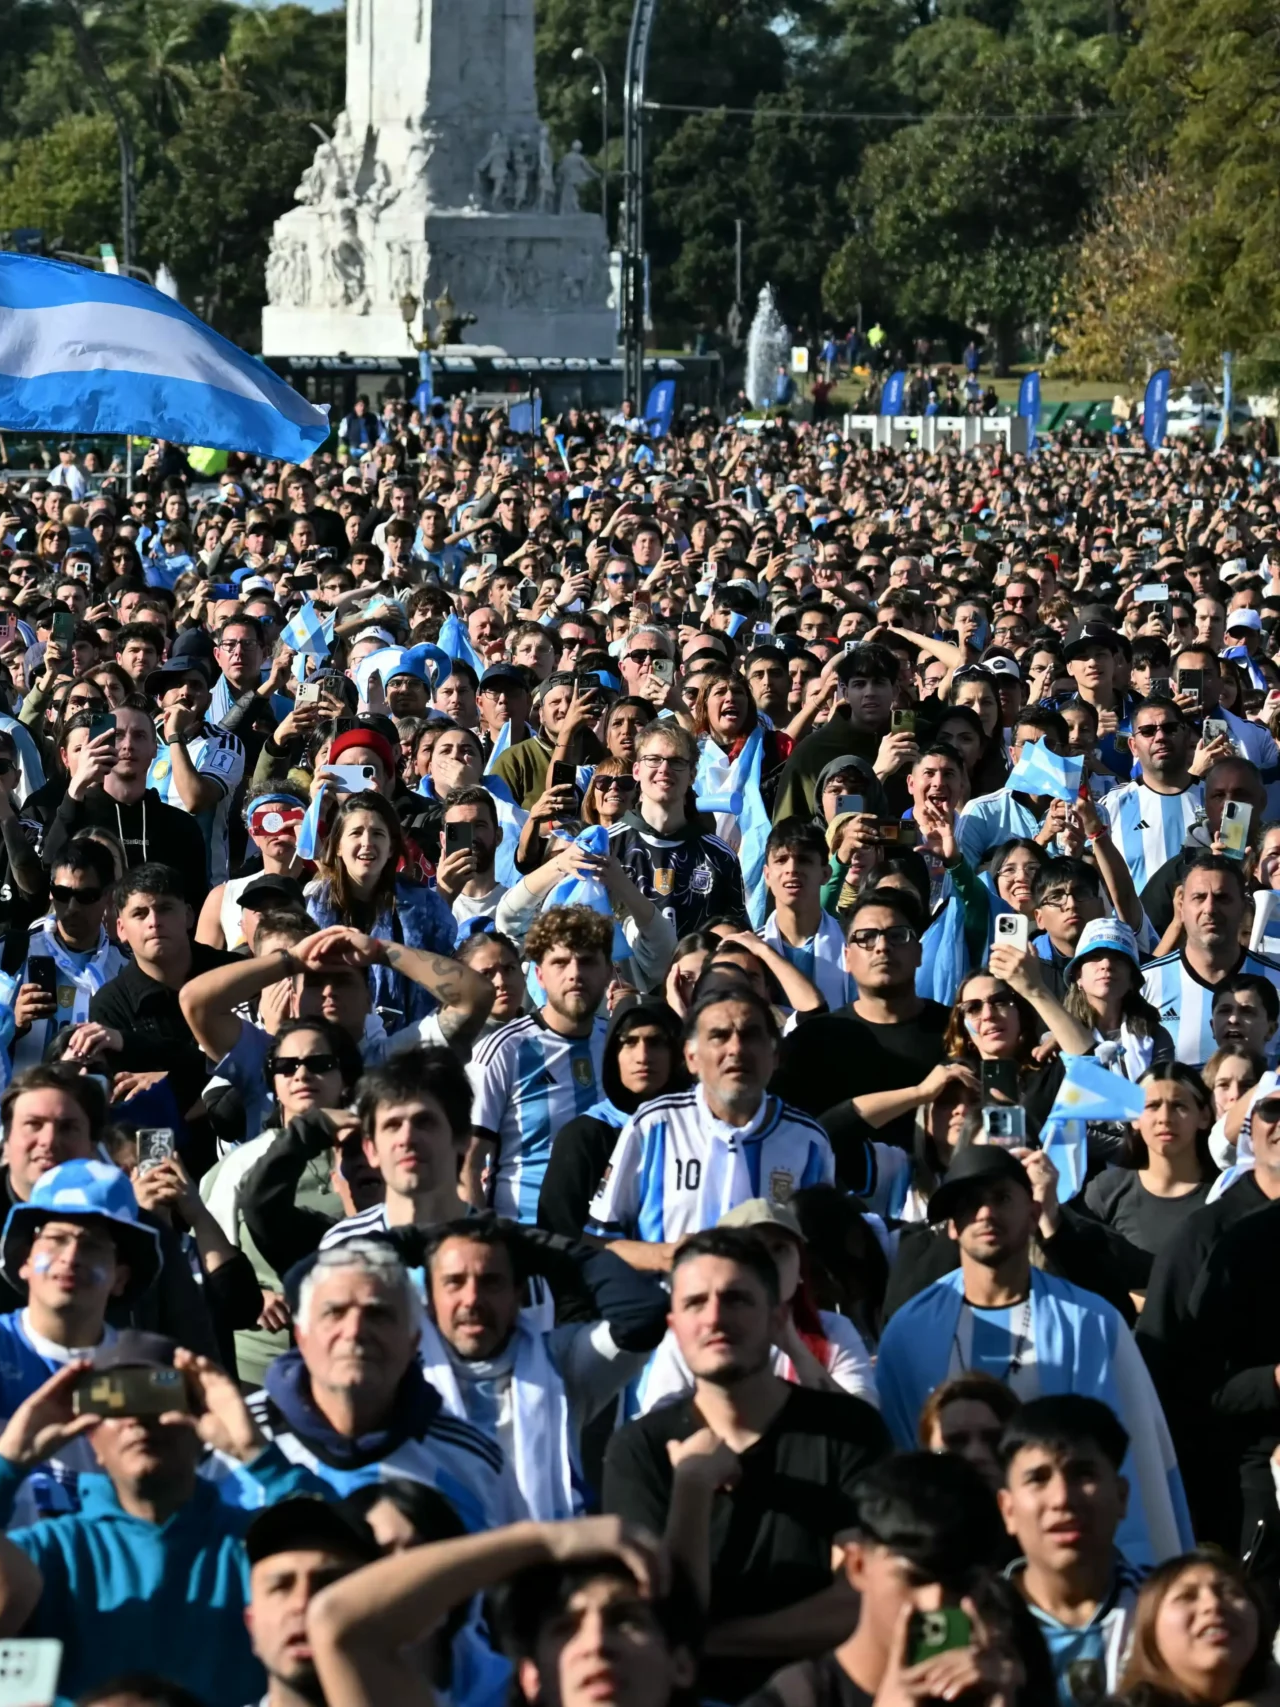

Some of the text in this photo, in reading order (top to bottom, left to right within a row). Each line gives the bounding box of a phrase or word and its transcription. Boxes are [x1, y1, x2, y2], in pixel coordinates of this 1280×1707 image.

[288, 356, 402, 370] WILDE
[774, 638, 786, 650] LA
[675, 1158, 701, 1191] 10
